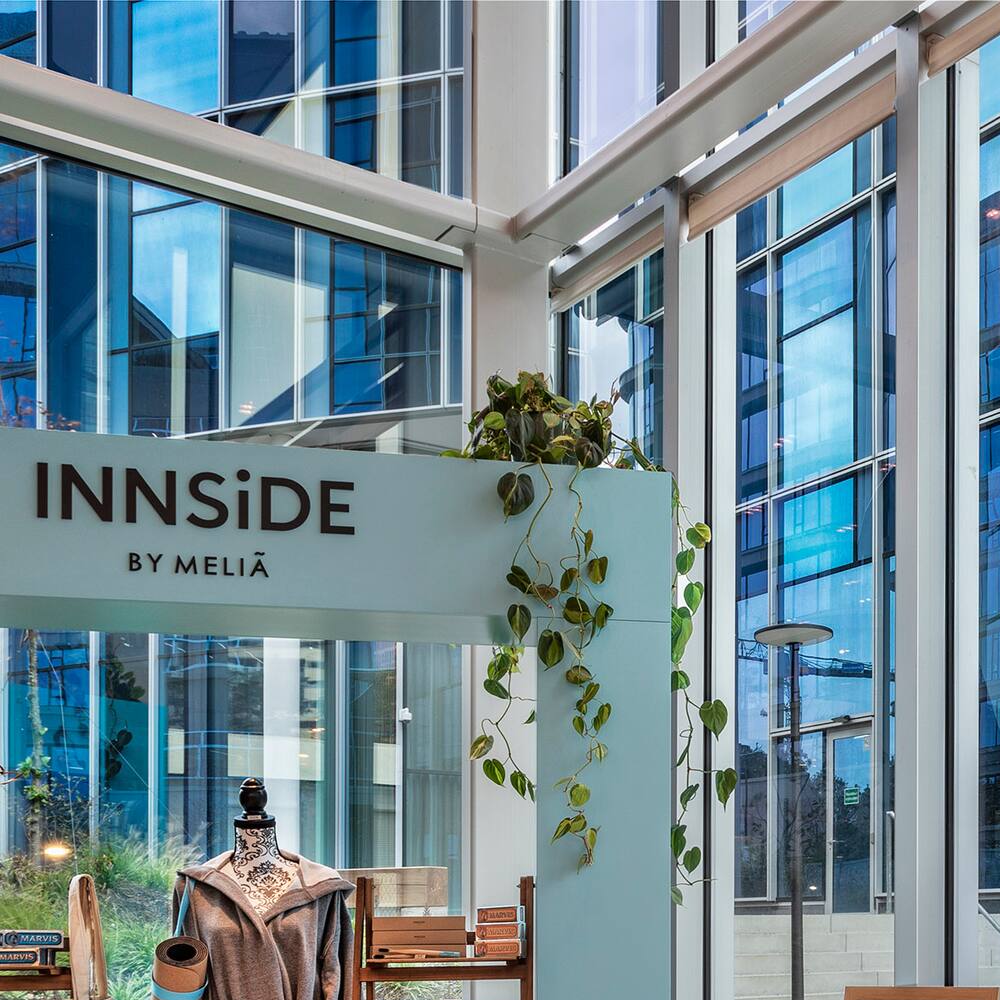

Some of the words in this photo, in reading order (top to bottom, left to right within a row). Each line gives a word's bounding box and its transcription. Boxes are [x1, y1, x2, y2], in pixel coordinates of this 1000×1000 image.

[36, 461, 355, 535] INNSiDE
[128, 552, 163, 573] BY
[20, 935, 59, 943] MARVIS
[0, 953, 34, 961] MARVIS
